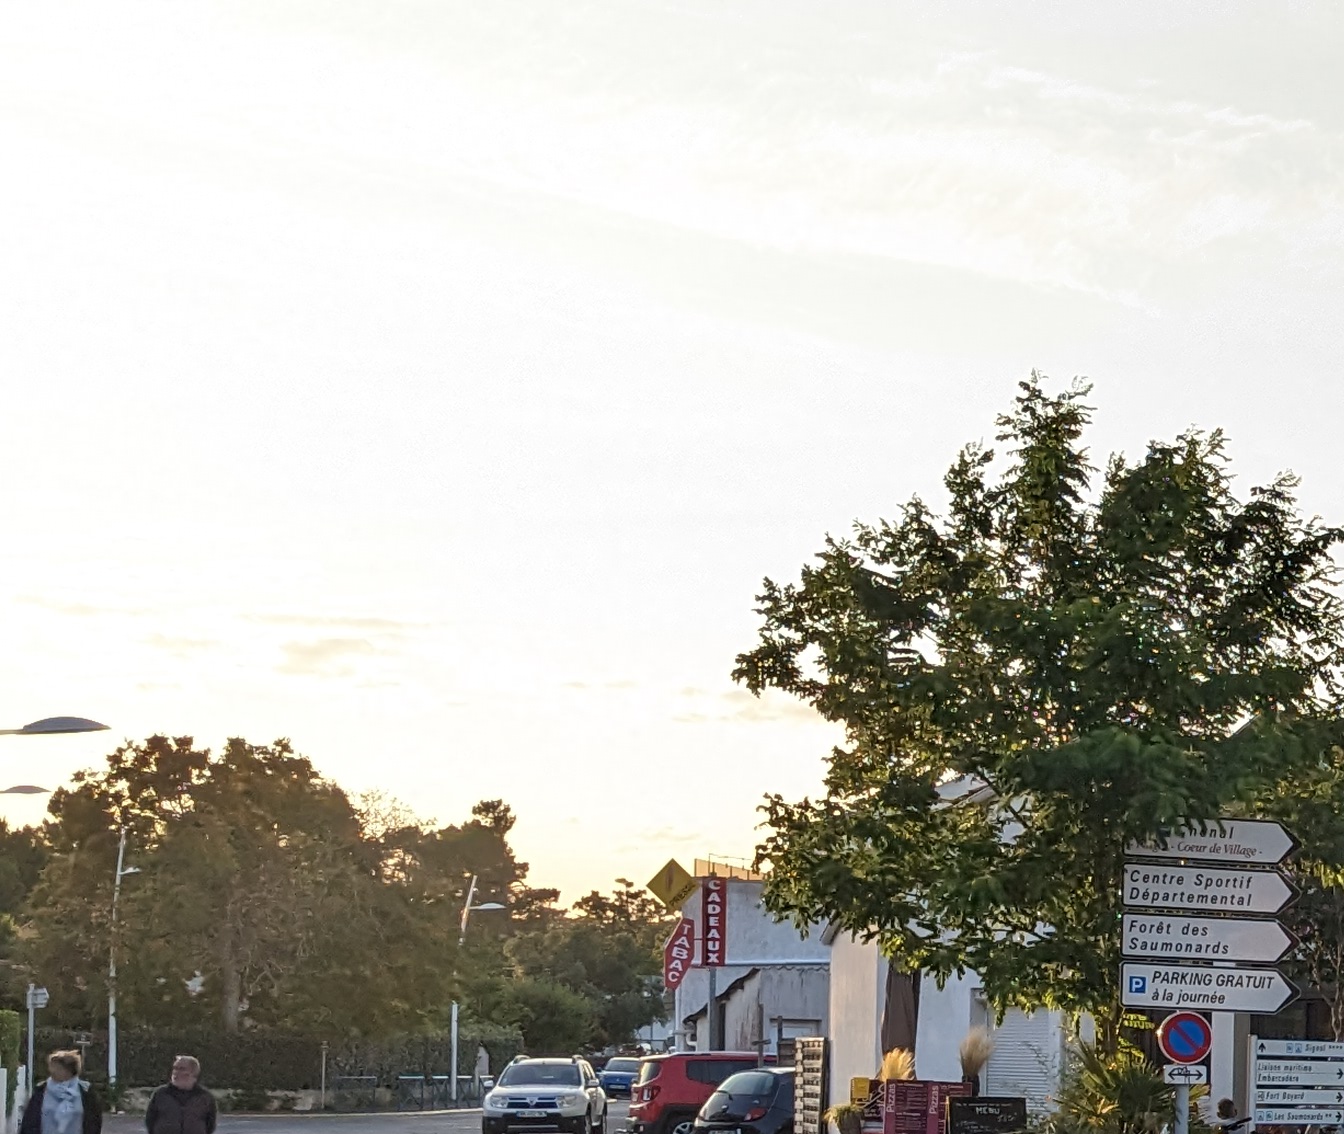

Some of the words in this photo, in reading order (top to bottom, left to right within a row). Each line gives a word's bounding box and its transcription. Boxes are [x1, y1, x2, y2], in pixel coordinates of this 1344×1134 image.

[1209, 844, 1222, 854] de
[1224, 844, 1257, 858] Village
[1130, 870, 1184, 885] Centre
[1194, 873, 1253, 890] Sportif
[1129, 887, 1252, 907] Départemental
[707, 880, 721, 963] CADEAUX
[1128, 920, 1171, 935] Forêt
[1182, 923, 1209, 937] des
[668, 924, 692, 983] TABAC
[1128, 937, 1229, 955] Saumonards
[1151, 970, 1213, 986] PARKING
[1216, 974, 1275, 989] GRATUIT
[1151, 988, 1159, 1001] à
[1162, 989, 1174, 1002] la
[1176, 989, 1226, 1005] journée
[886, 1083, 896, 1113] Pizzas
[929, 1085, 939, 1115] Pizzas
